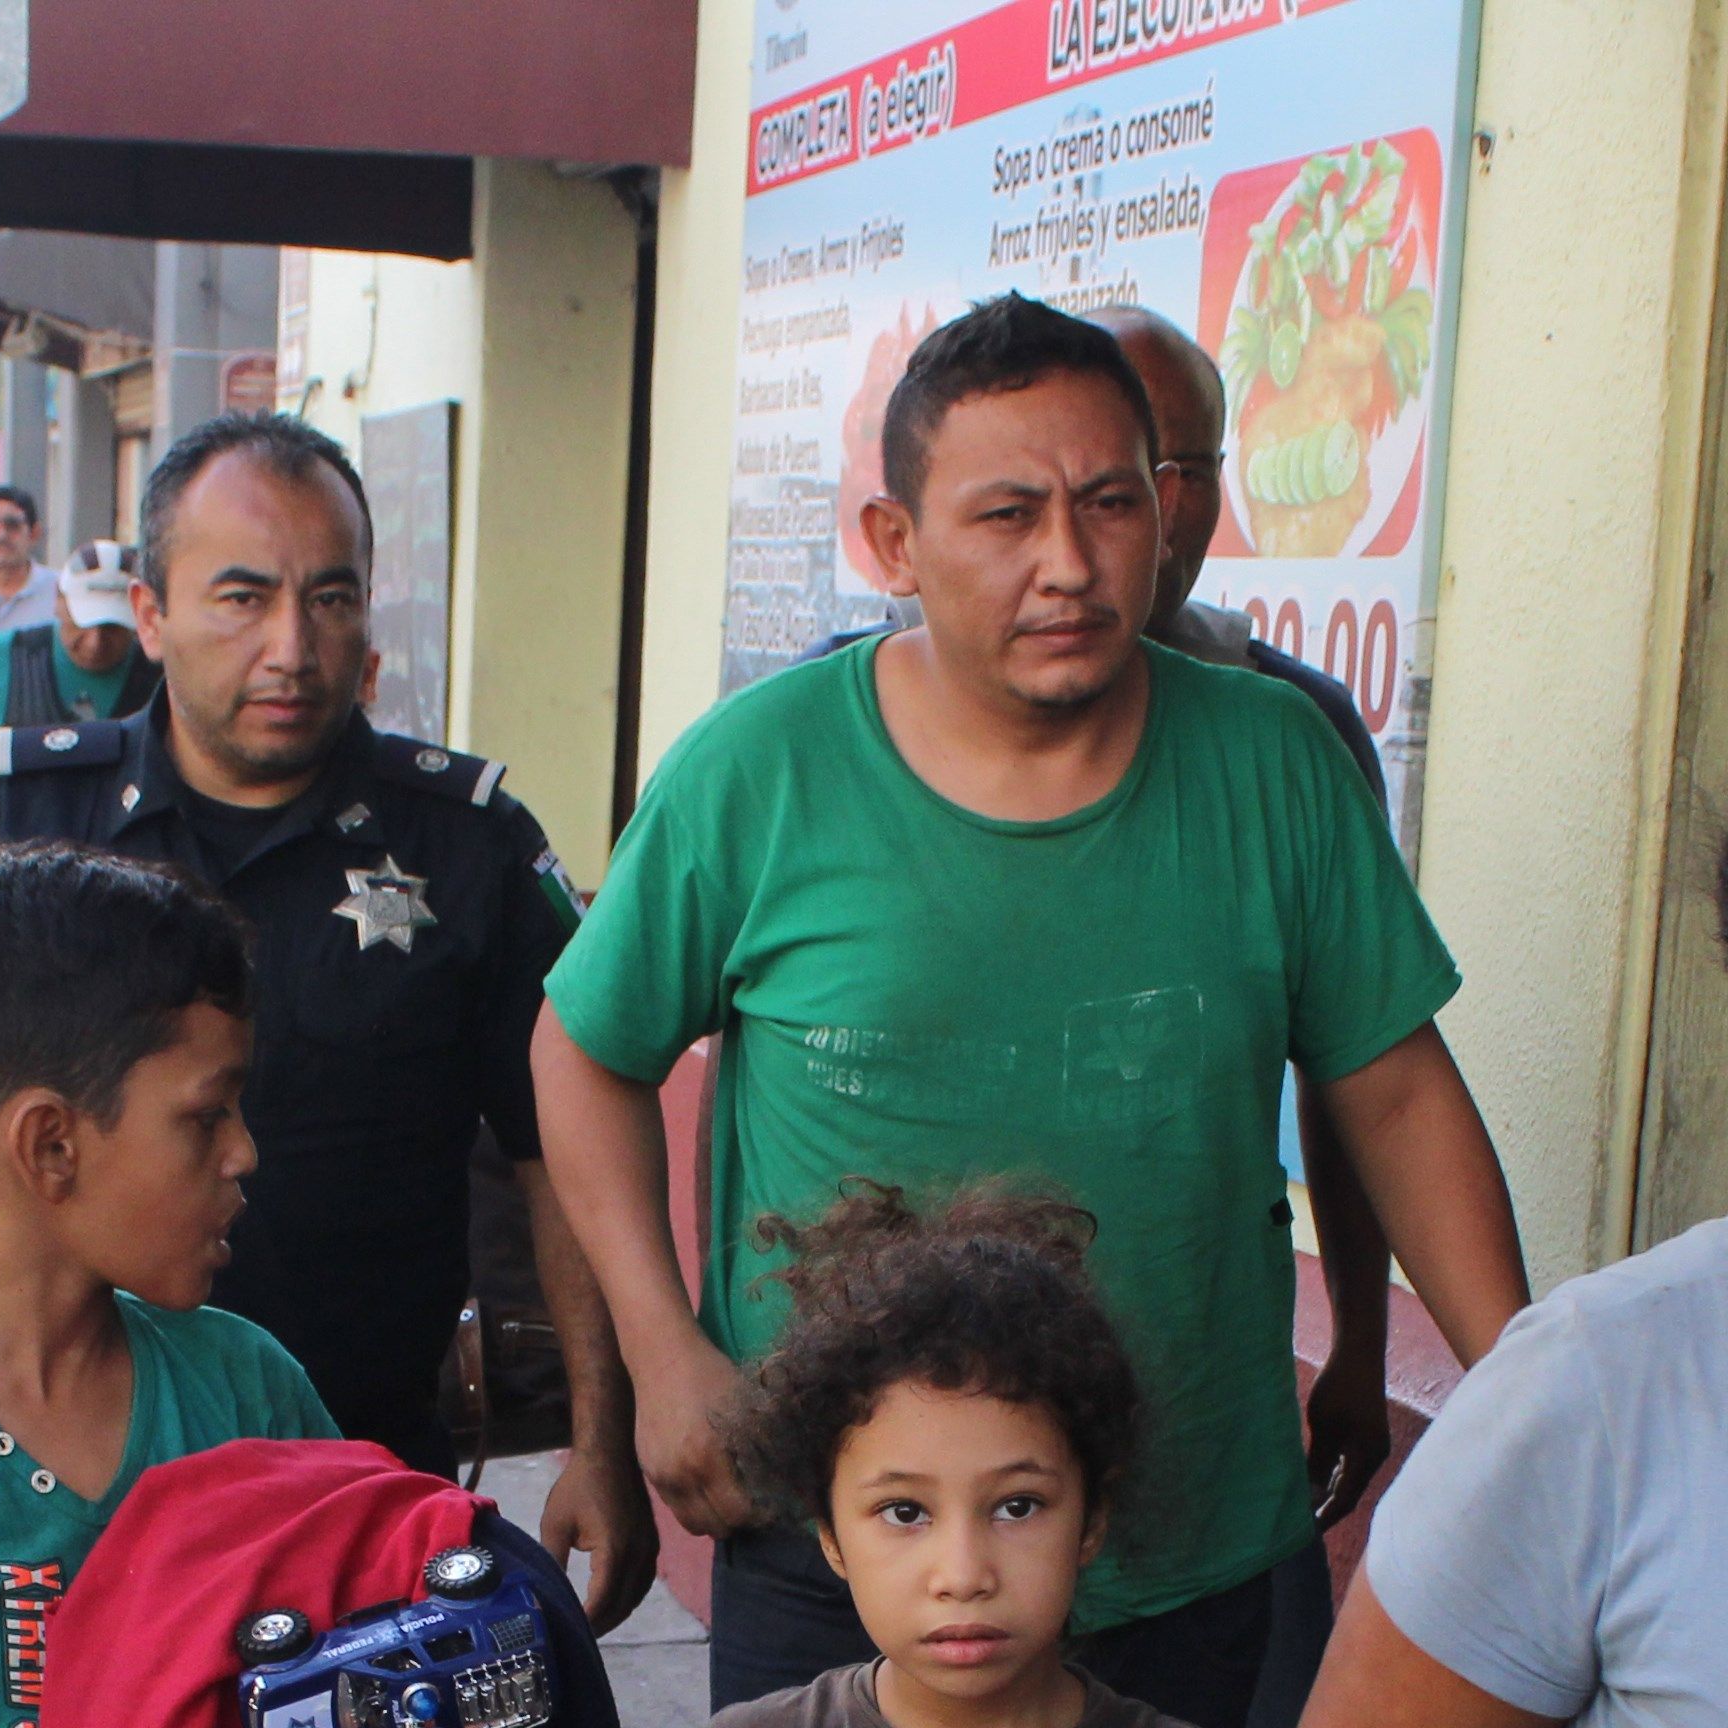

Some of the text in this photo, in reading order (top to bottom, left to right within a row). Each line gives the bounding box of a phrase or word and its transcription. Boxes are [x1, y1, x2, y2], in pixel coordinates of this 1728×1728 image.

[1047, 0, 1266, 80] LA EJECU
[756, 87, 852, 182] COMPLETA
[884, 40, 957, 140] elegir)
[992, 76, 1214, 200] Sopa o crema o consomé
[988, 171, 1207, 268] Arroz frijoles y ensalada,
[1043, 266, 1138, 309] panizado
[322, 1635, 376, 1660] FEDERAL
